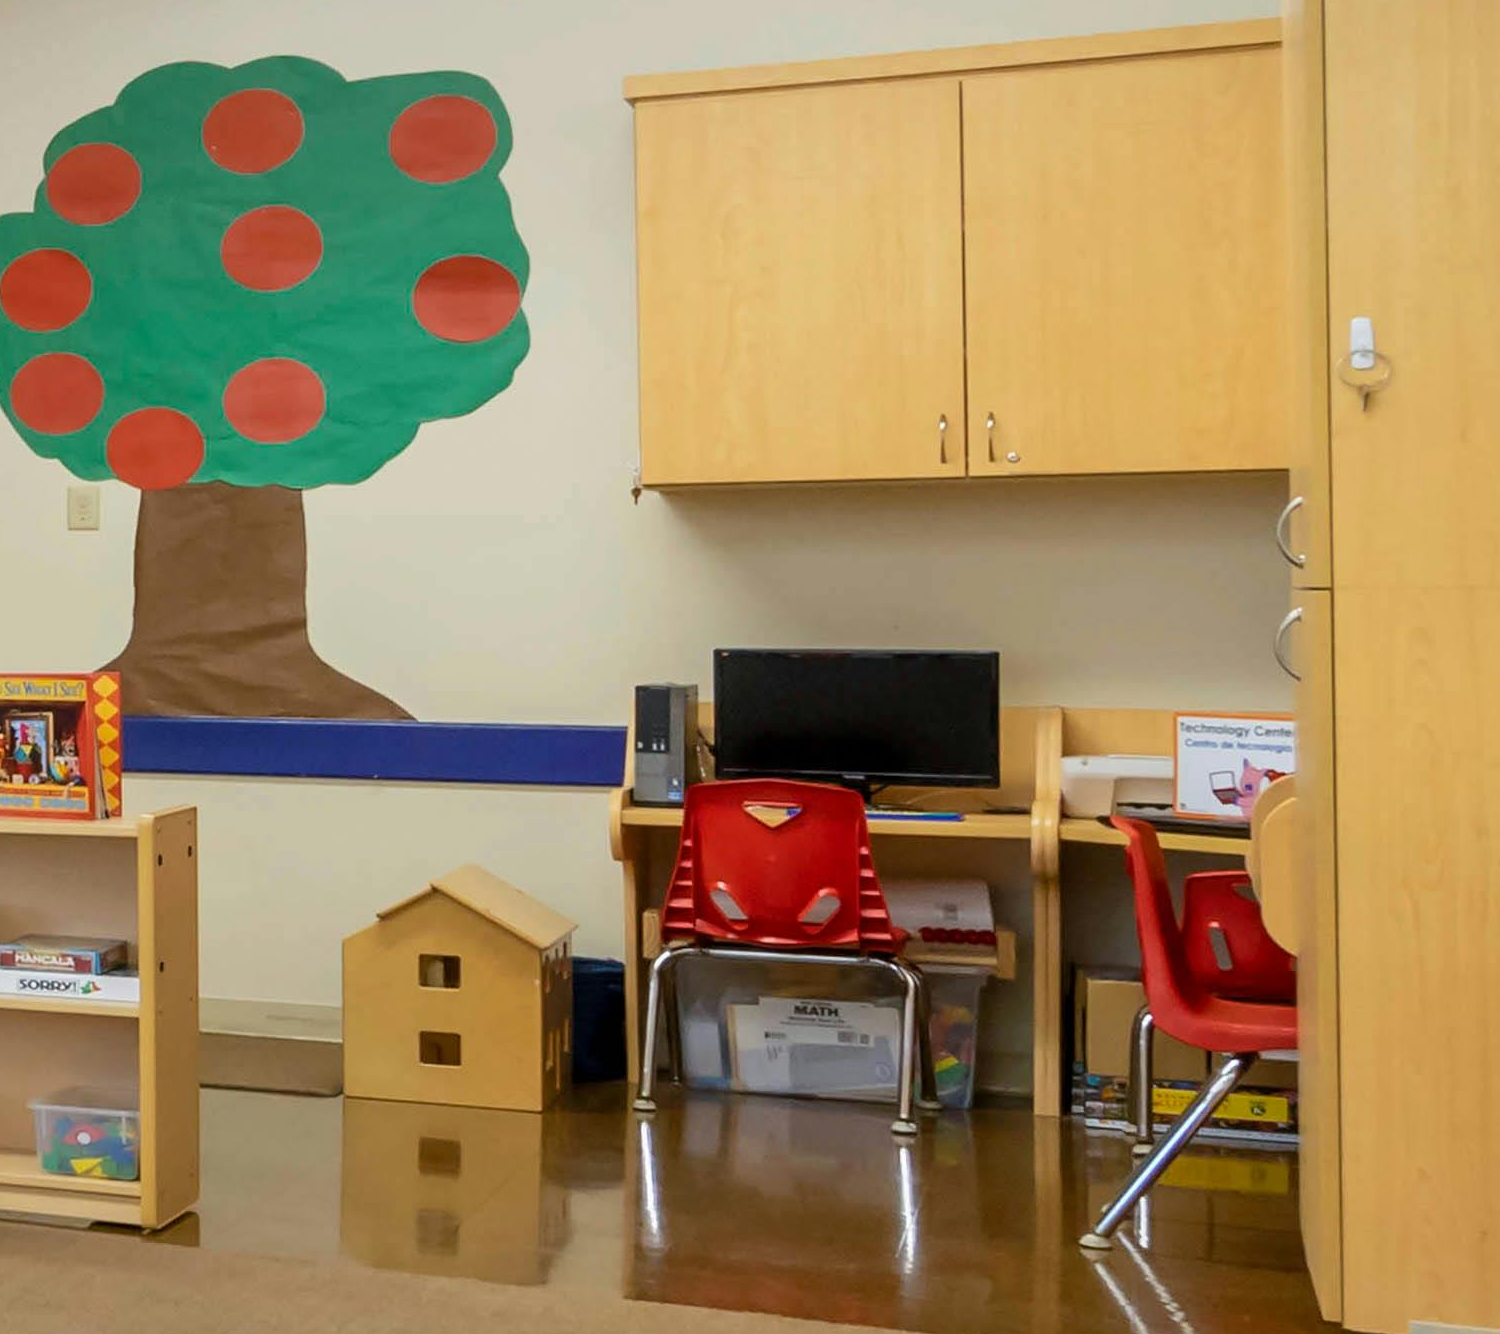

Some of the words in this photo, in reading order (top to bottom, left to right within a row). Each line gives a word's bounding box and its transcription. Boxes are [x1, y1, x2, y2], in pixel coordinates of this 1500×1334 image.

[1180, 722, 1250, 737] Technology
[1254, 726, 1292, 737] Cente
[1185, 738, 1218, 748] Centro
[1221, 740, 1233, 748] de
[15, 953, 76, 967] MANCALA
[18, 978, 77, 993] SORRY!
[794, 1005, 839, 1017] MATH
